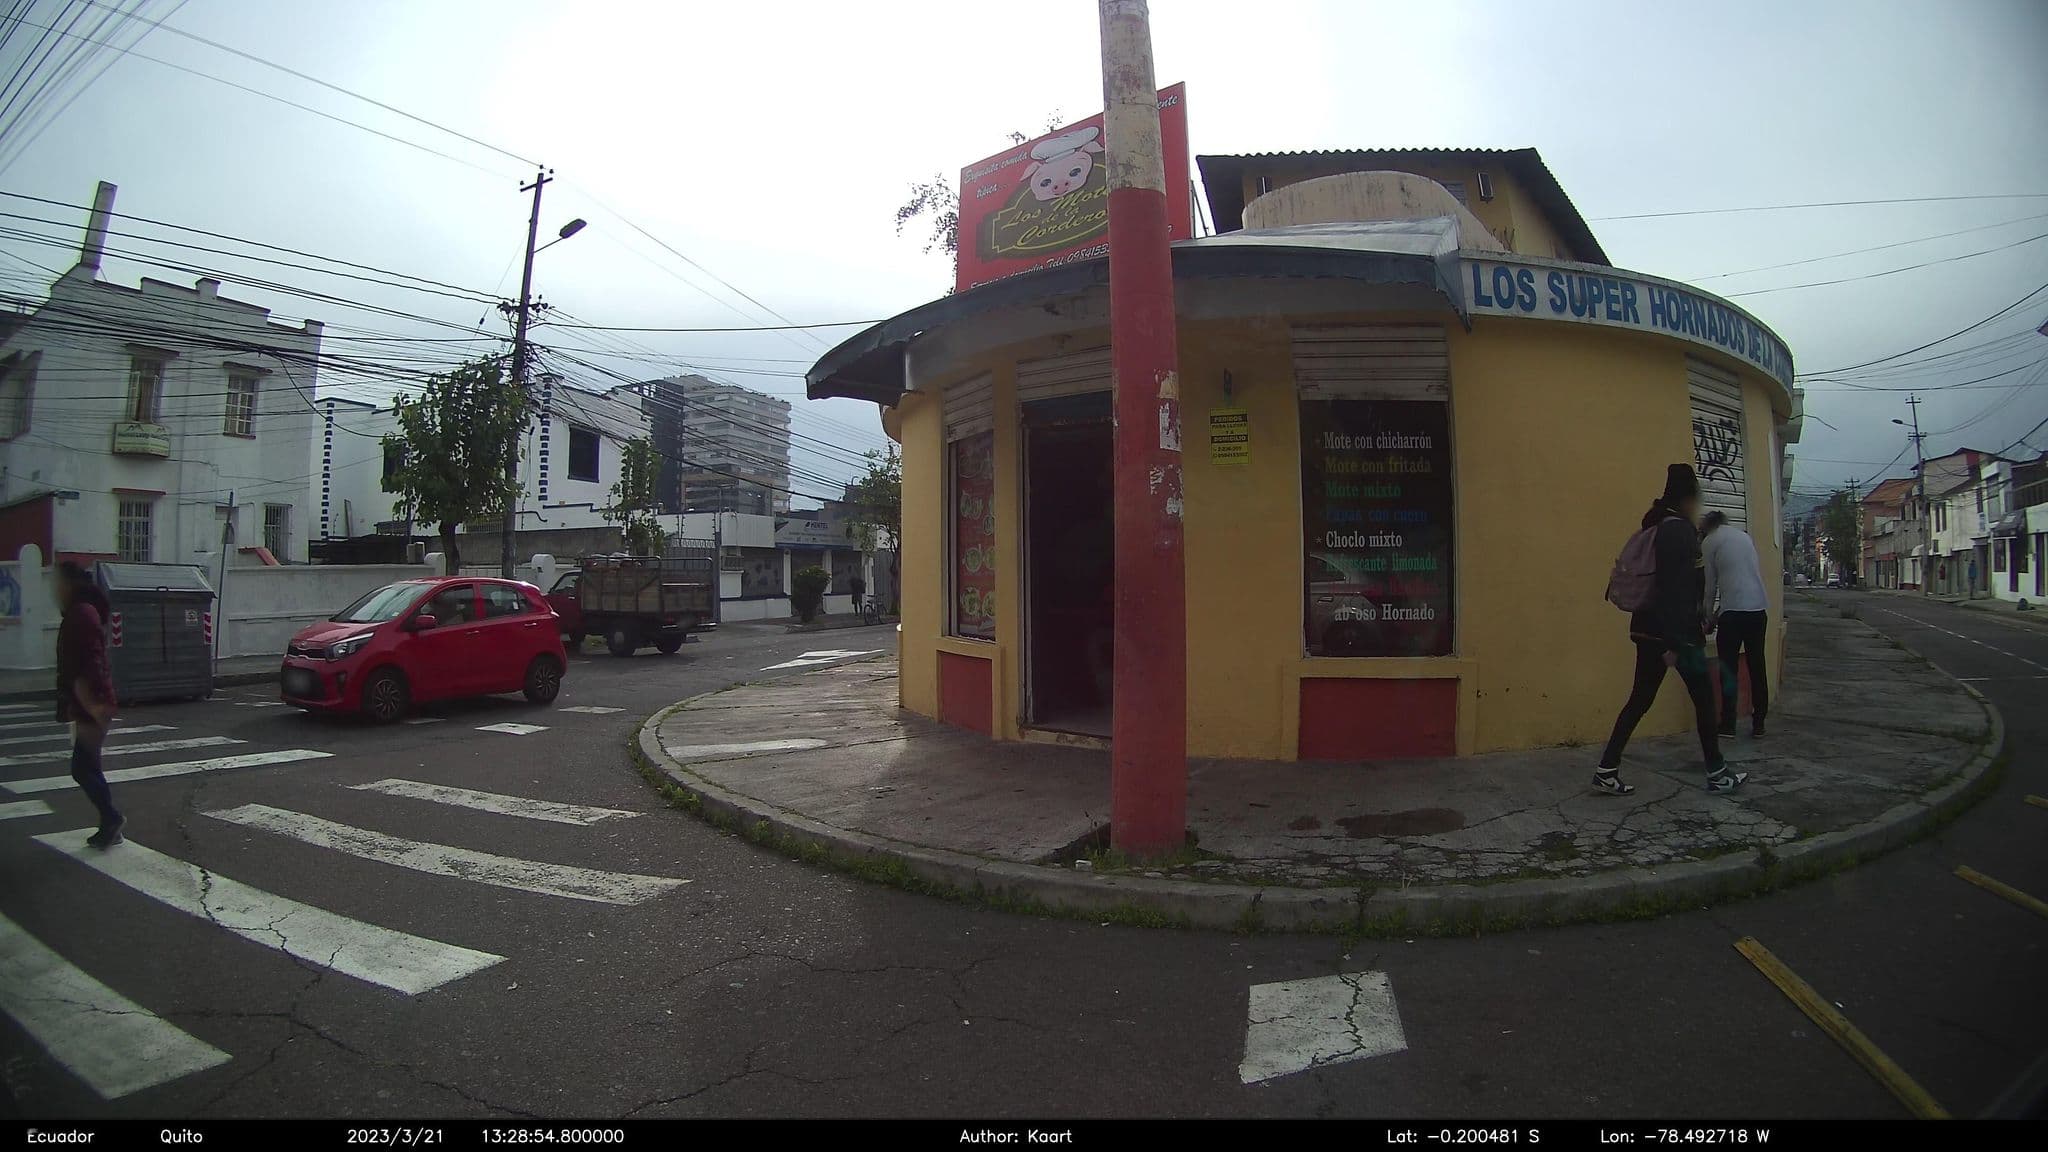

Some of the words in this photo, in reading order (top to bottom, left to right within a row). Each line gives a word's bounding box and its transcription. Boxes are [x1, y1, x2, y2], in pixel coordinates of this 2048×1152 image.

[1472, 263, 1537, 312] LOS
[1547, 271, 1640, 324] SUPER
[1647, 286, 1745, 355] HORNADOS
[1745, 321, 1761, 363] DE
[1324, 431, 1352, 449] Mote
[1354, 435, 1373, 449] con
[1375, 431, 1433, 449] chicharrón
[1325, 457, 1358, 473] Mote
[1361, 461, 1384, 473] con
[1388, 456, 1432, 473] fritada
[1364, 481, 1402, 497] mixto
[1325, 530, 1366, 548] Choclo
[1368, 531, 1403, 548] mixto
[1381, 603, 1435, 621] Hornado
